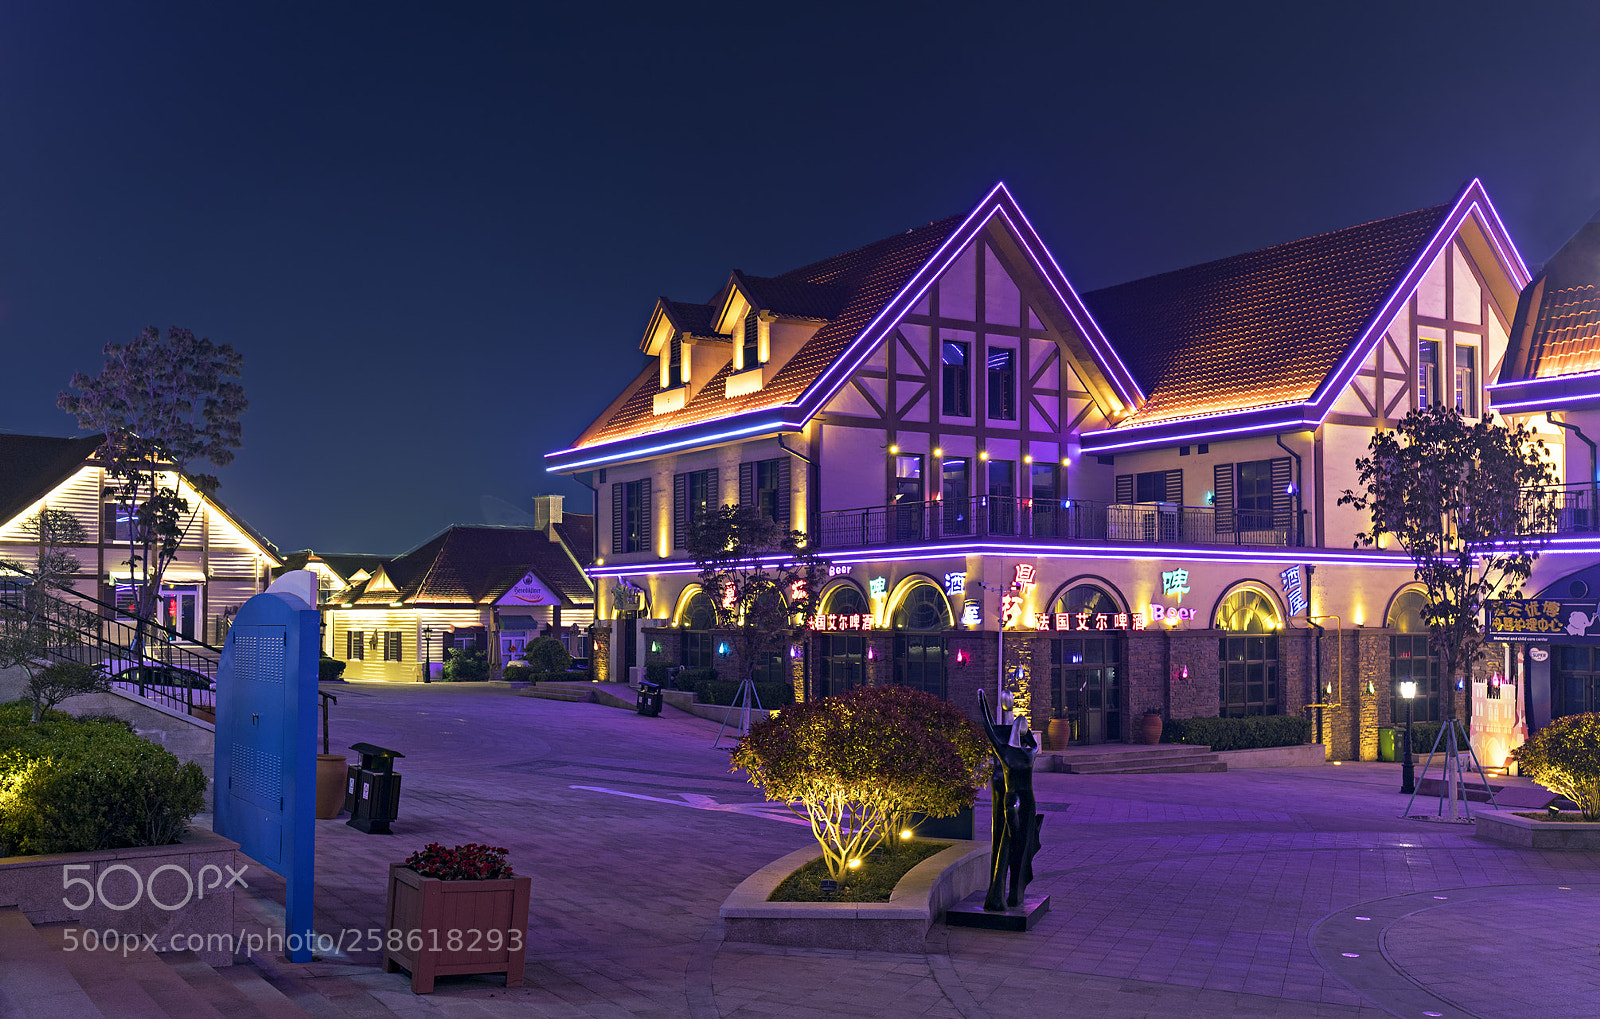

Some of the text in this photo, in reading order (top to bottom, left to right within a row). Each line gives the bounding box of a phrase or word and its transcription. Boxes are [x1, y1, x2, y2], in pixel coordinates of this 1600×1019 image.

[829, 565, 852, 577] Beer
[1162, 568, 1191, 604] 啤
[1280, 564, 1308, 617] 酒屋
[1035, 612, 1146, 631] 法国艾尔啤酒
[1150, 603, 1198, 622] Beer
